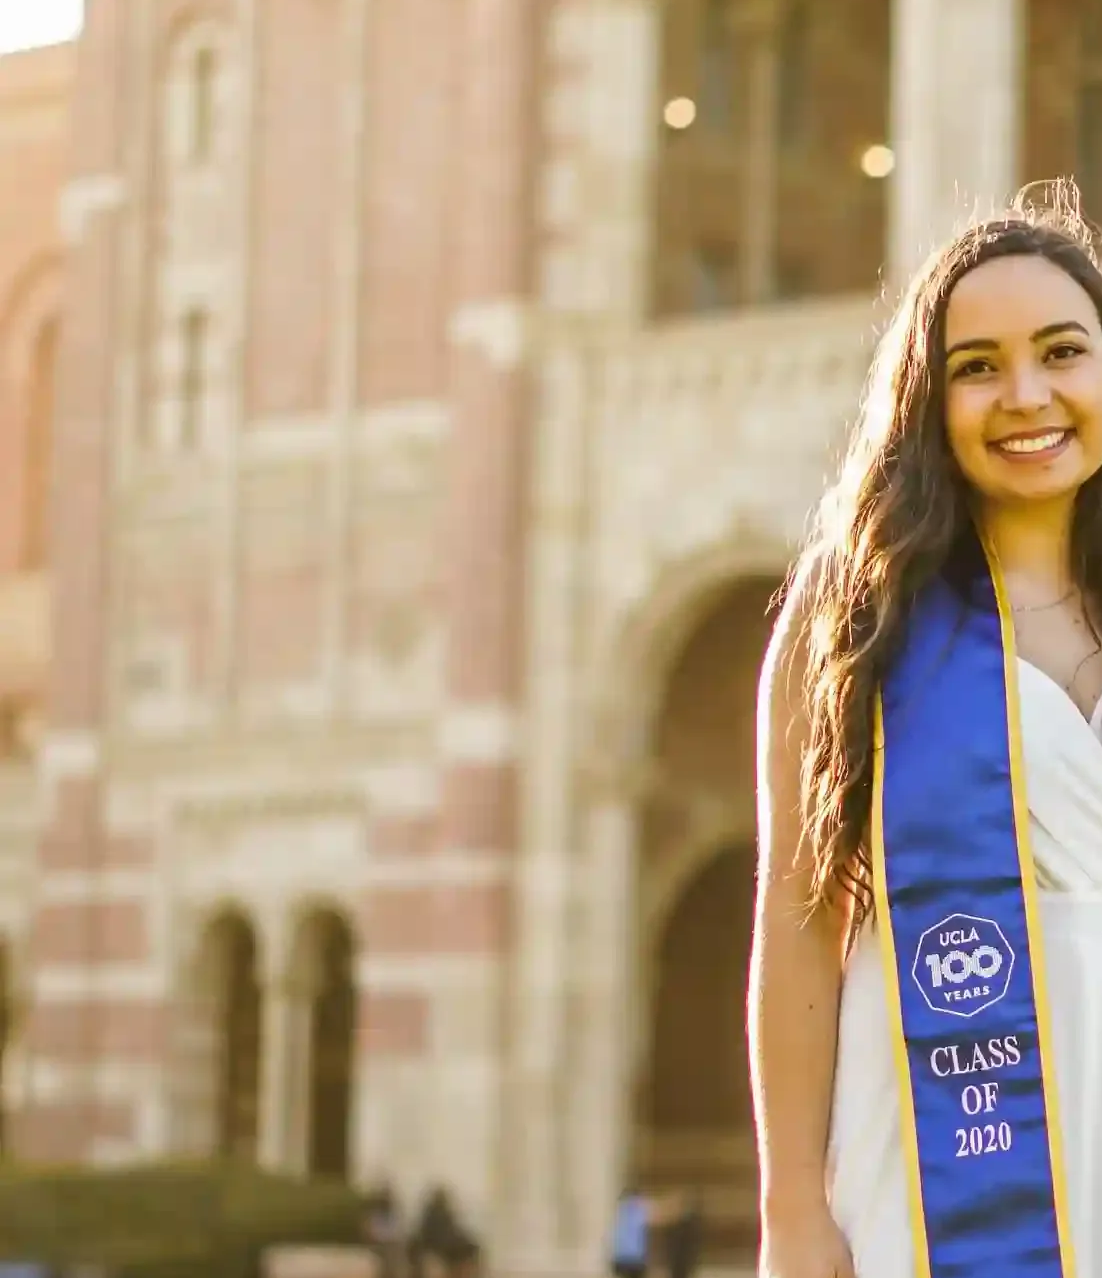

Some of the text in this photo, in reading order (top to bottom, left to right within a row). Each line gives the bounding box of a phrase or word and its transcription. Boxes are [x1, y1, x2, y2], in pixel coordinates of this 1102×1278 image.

[939, 927, 980, 947] UCLA
[925, 945, 1002, 988] 100
[943, 985, 990, 1003] YEARS
[930, 1035, 1021, 1077] CLASS
[961, 1082, 999, 1115] OF
[955, 1121, 1012, 1157] 2020
